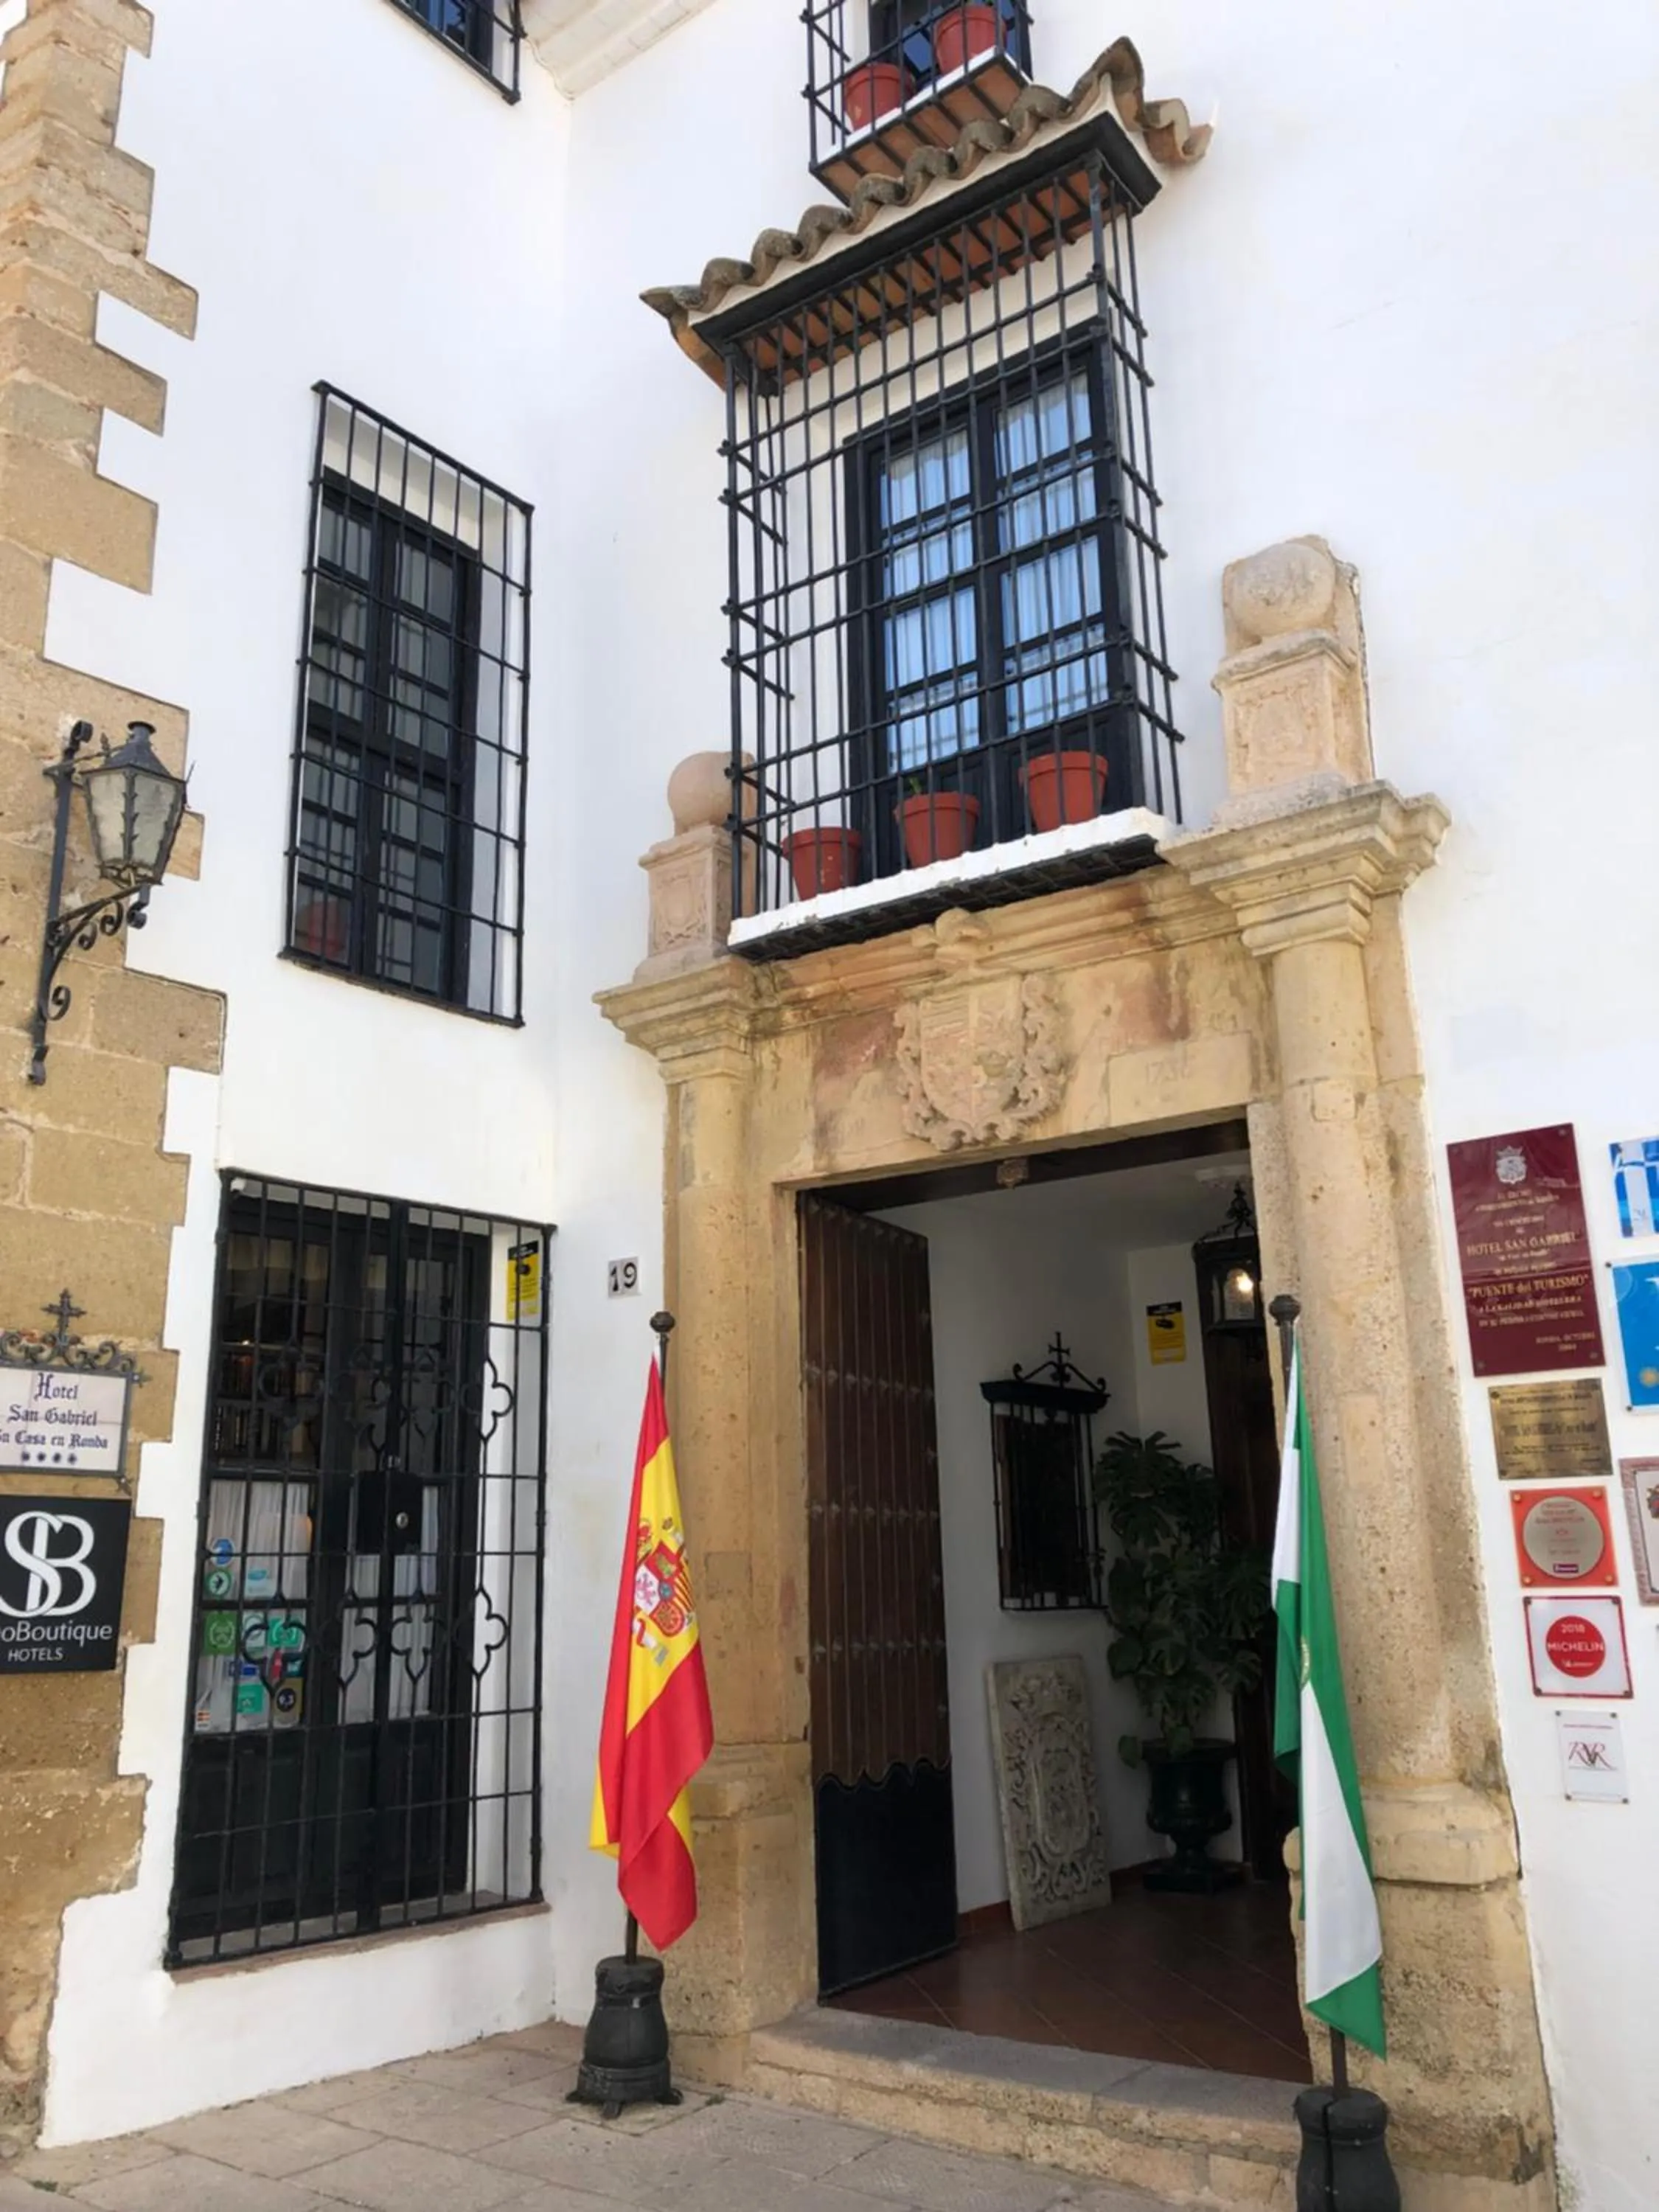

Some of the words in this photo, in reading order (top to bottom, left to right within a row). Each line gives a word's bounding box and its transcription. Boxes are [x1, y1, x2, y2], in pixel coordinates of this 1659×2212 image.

[1467, 1241, 1503, 1256] HOTEL
[610, 1262, 637, 1292] 19
[34, 1372, 79, 1401] Hotel
[7, 1404, 39, 1423] San
[45, 1407, 97, 1427] Gabriel
[15, 1430, 46, 1446] Casa
[51, 1436, 65, 1447] en
[68, 1433, 108, 1450] Ronda
[7, 1647, 63, 1662] HOTELS
[1548, 1641, 1604, 1652] MICHELIN
